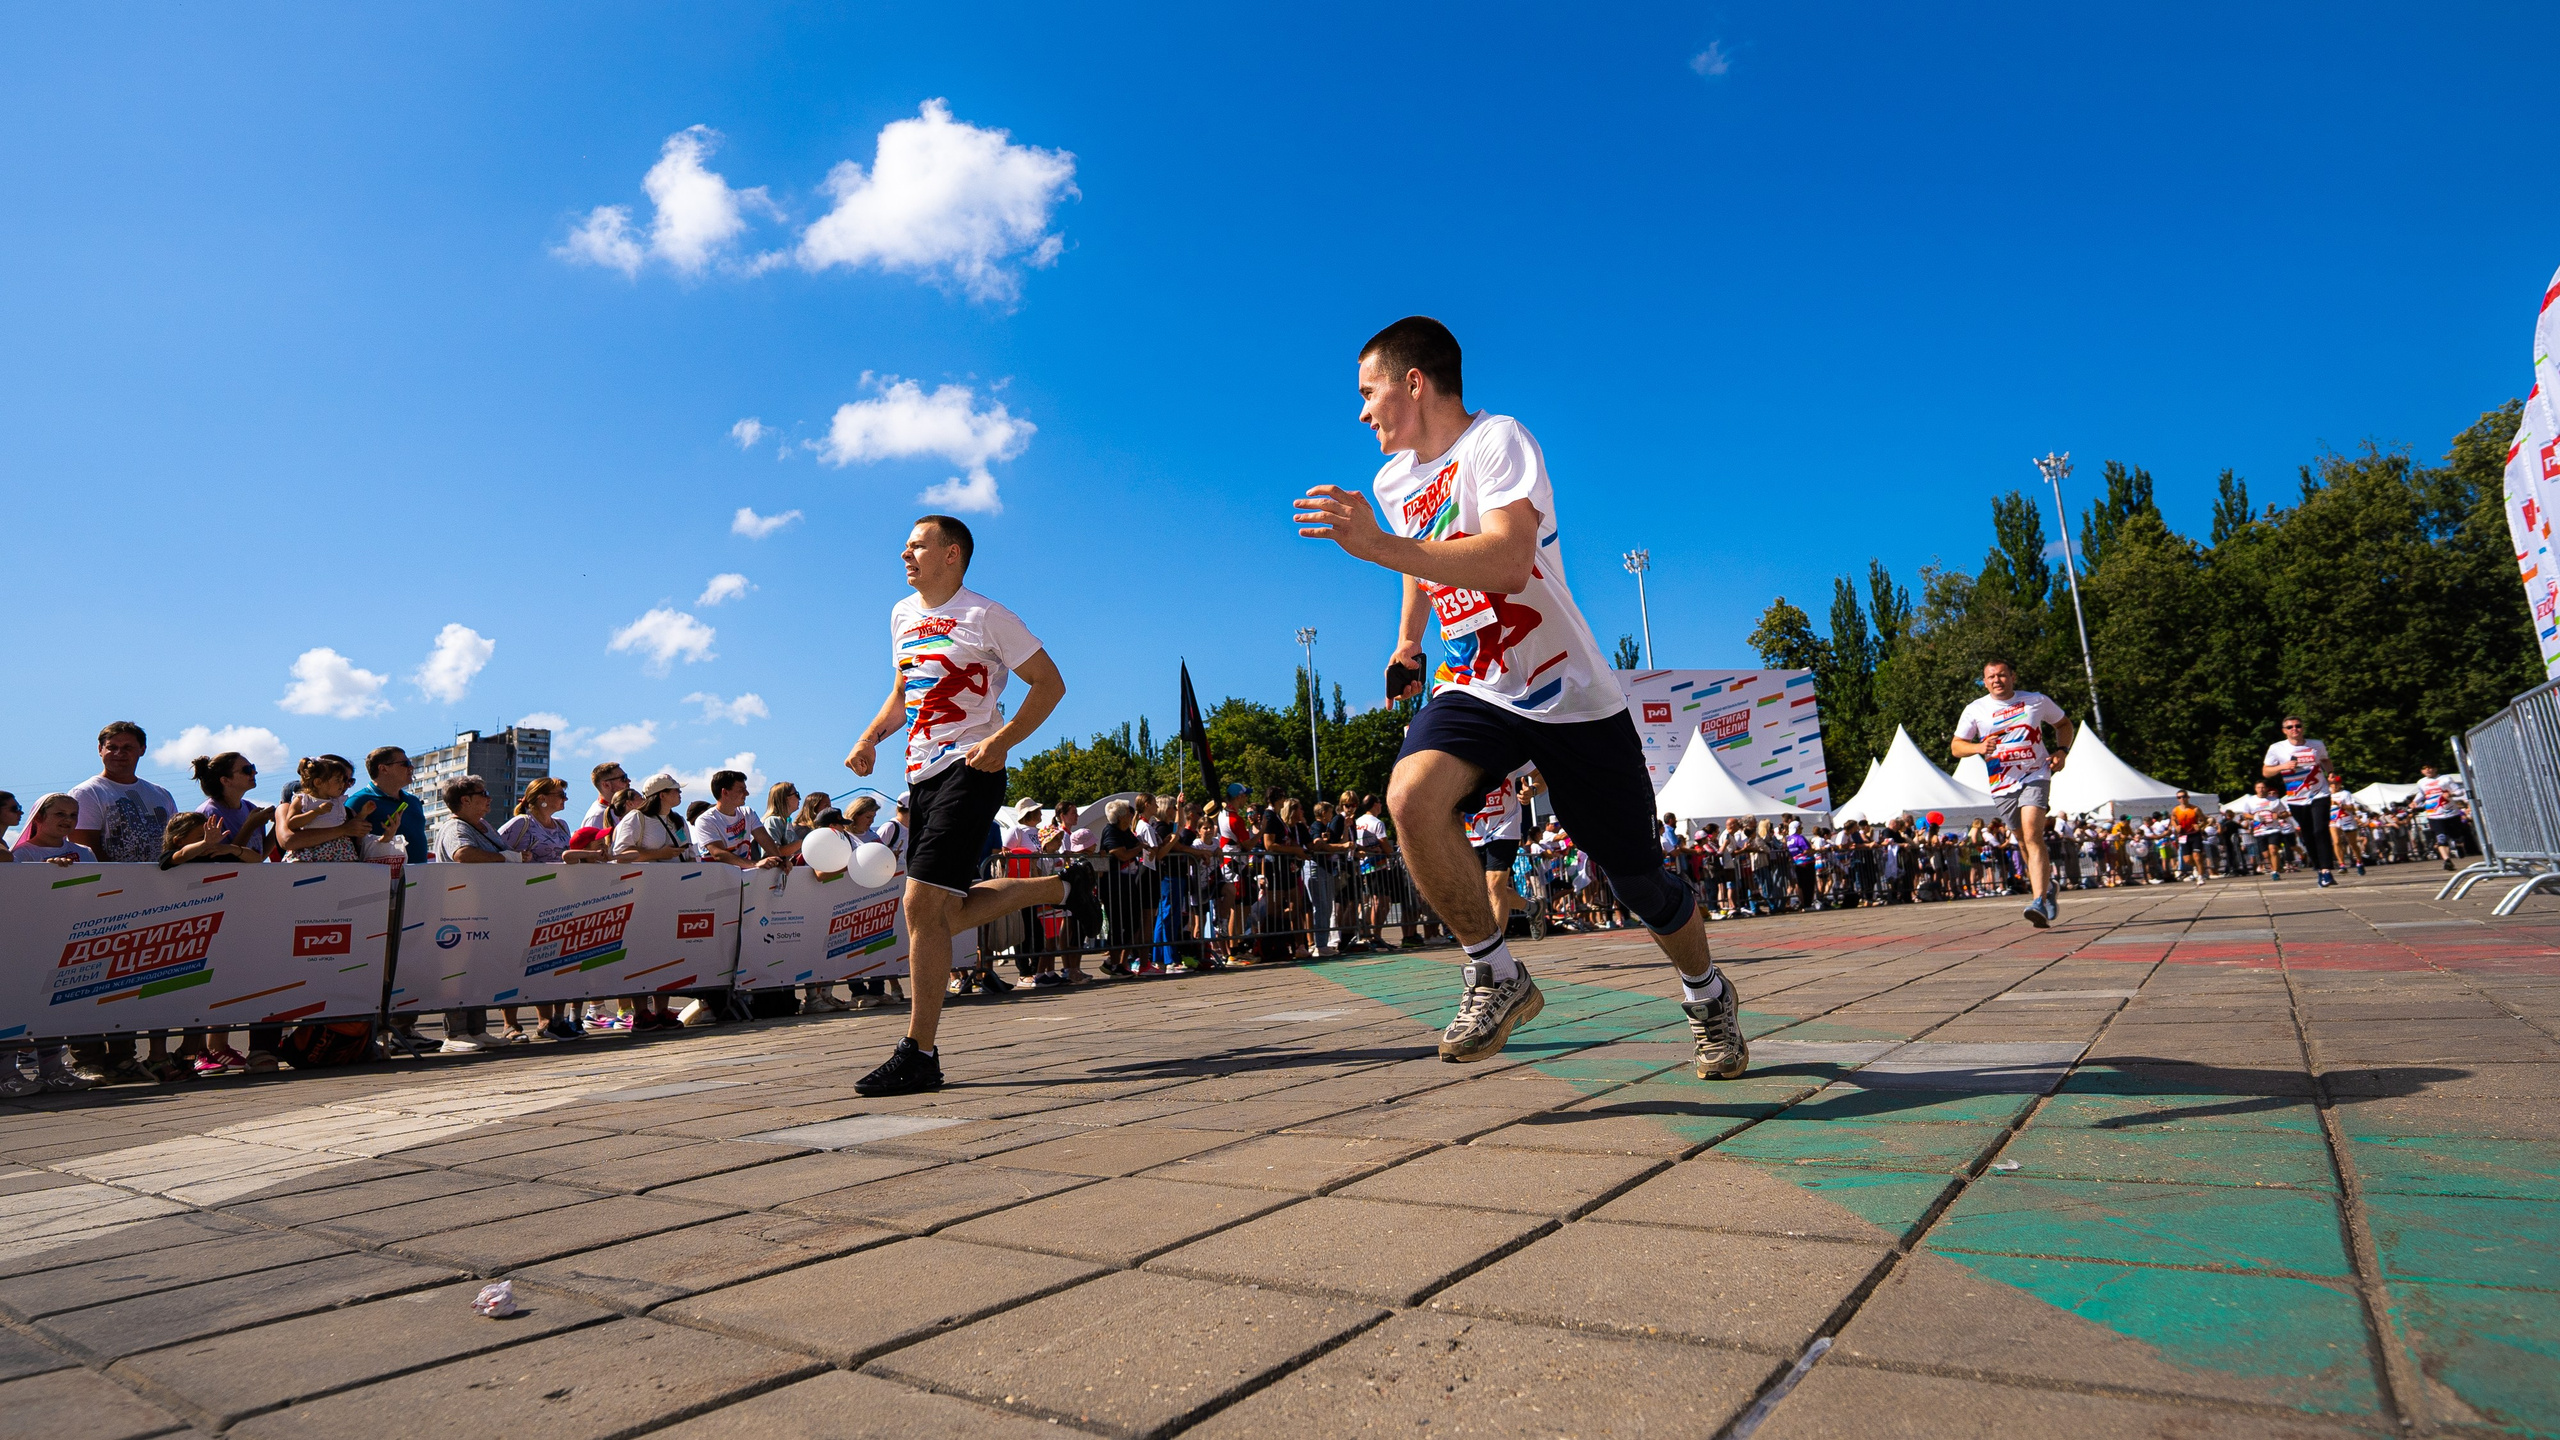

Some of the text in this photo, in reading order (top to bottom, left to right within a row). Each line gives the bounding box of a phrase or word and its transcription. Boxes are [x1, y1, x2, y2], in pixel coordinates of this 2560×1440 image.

[1437, 588, 1486, 620] 2394
[1703, 710, 1748, 733] ДОСТИГАЯ
[1719, 720, 1747, 738] ЦЕЛИ!
[2008, 749, 2033, 760] 1966
[1486, 795, 1501, 806] 87
[72, 892, 224, 931] СПОРТИВНО-МУЗЫКАЛЬНЫЙ
[538, 887, 634, 918] СПОРТИВНО-МУЗЫКАЛЬНЫЙ
[535, 906, 627, 945] ДОСТИГАЯ
[536, 911, 574, 926] ПРАЗДНИК
[832, 900, 895, 933] ДОСТИГАЯ
[853, 913, 893, 938] ЦЕЛИ!
[67, 915, 213, 966] ДОСТИГАЯ
[68, 921, 130, 941] ПРАЗДНИК
[466, 930, 490, 941] ТМХ
[565, 922, 623, 951] ЦЕЛИ!
[776, 931, 801, 939] Sobytie
[115, 936, 206, 974] ЦЕЛИ!
[526, 950, 556, 964] СЕМЬИ
[53, 971, 100, 989] СЕМЬИ
[56, 961, 103, 979] ДЛЯ ВСЕЙ
[64, 988, 91, 1000] ЧЕСТЬ
[91, 983, 111, 995] ДНЯ
[113, 962, 202, 989] ЖЕЛЕЗНОДОРОЖНИКА
